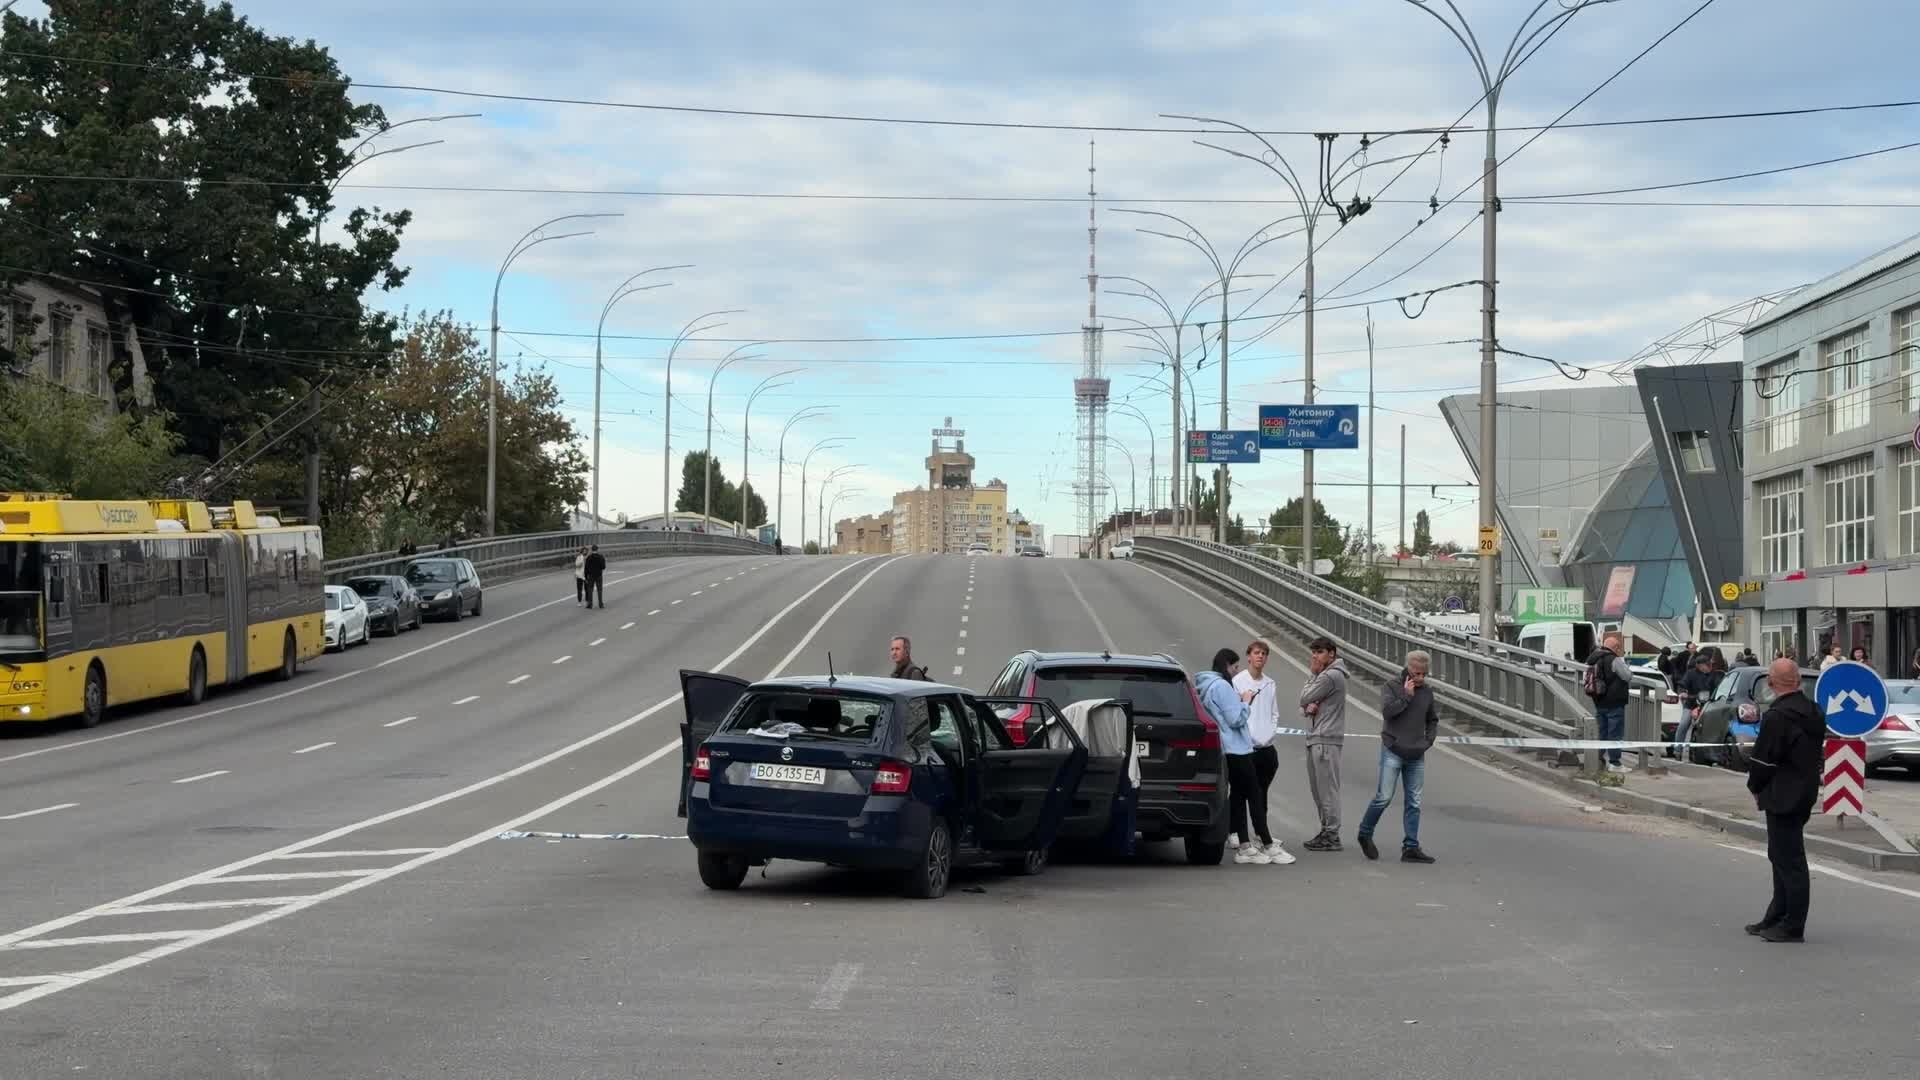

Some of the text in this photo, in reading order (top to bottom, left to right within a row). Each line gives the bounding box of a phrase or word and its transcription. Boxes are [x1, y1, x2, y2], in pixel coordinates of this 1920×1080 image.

[1288, 407, 1335, 418] Житомир
[1288, 418, 1324, 426] Zhytomyr
[1211, 432, 1235, 441] Одеса
[1287, 428, 1316, 438] Львів
[1481, 539, 1493, 550] 20
[1546, 591, 1569, 602] EXIT
[1546, 603, 1580, 615] GAMES
[757, 765, 821, 782] BO 6135 EA
